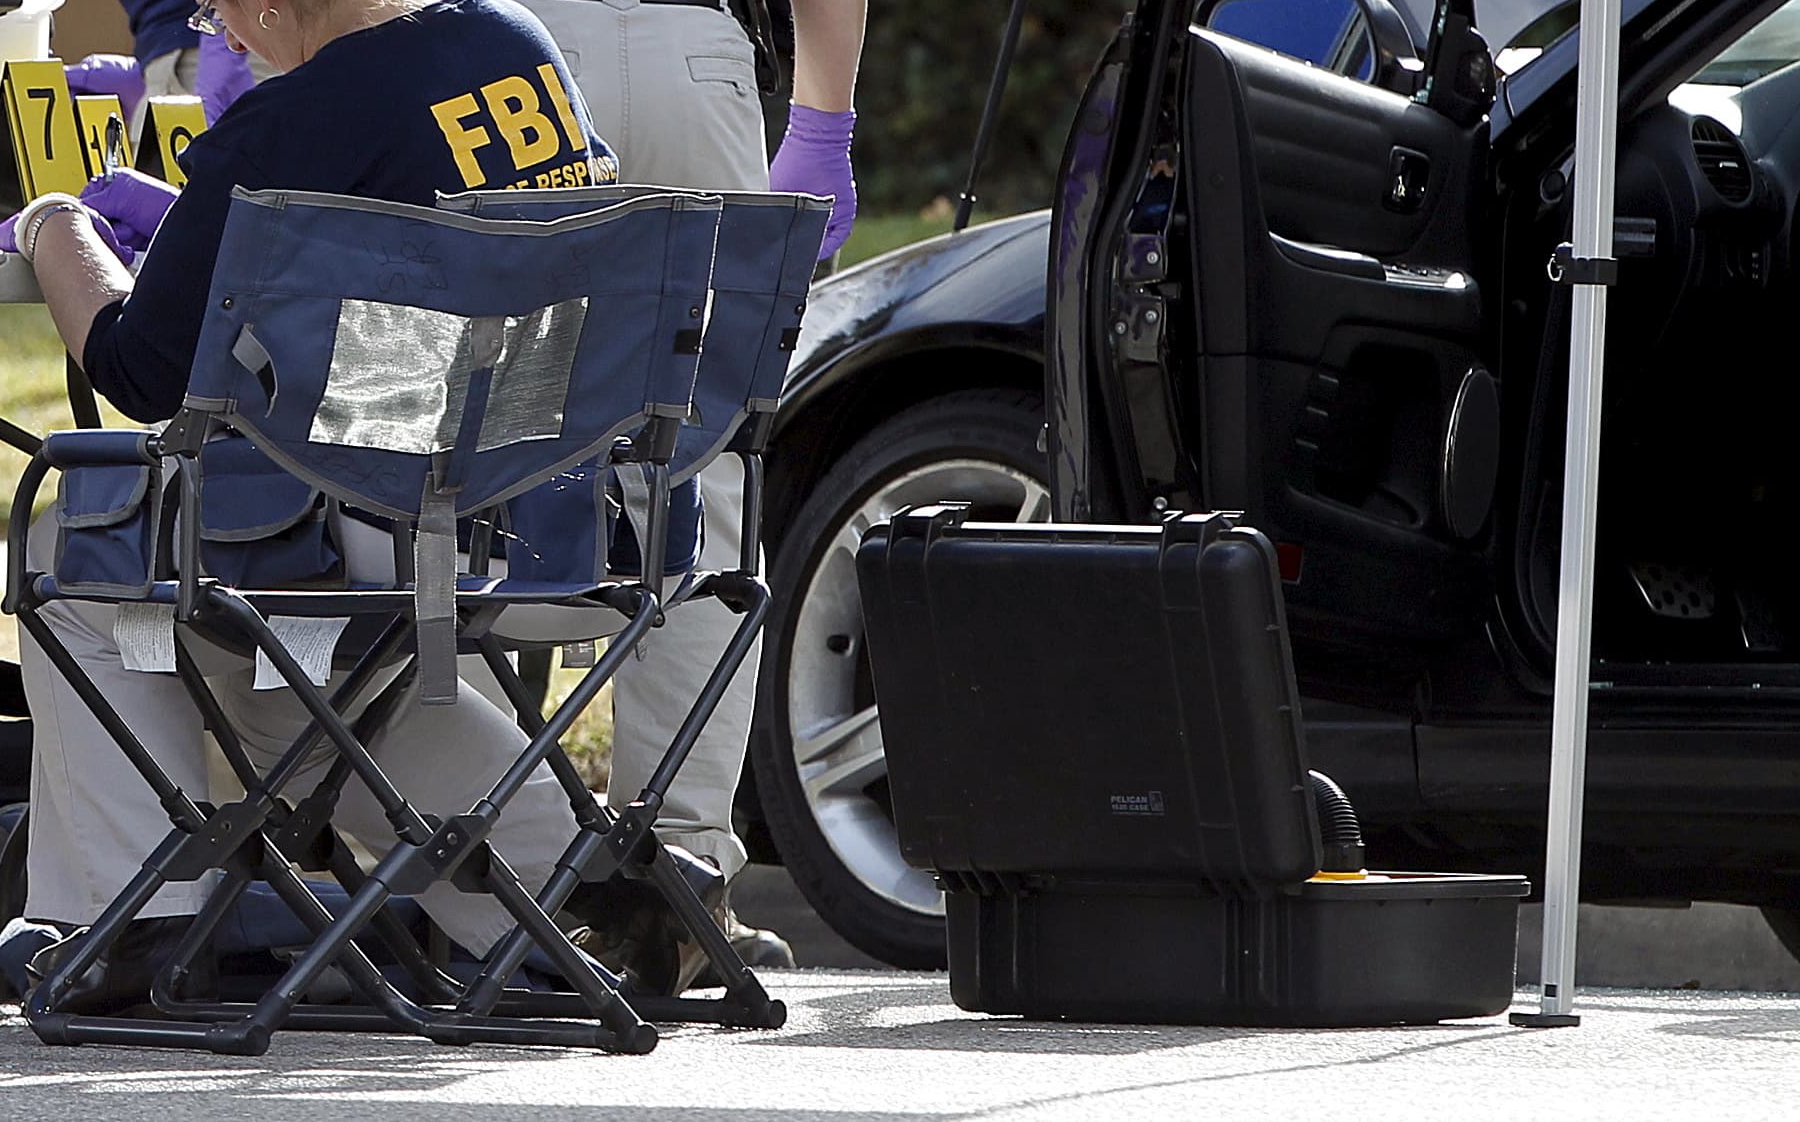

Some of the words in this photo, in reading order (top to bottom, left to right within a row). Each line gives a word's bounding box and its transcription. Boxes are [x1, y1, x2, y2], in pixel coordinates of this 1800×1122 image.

[27, 88, 55, 160] 7
[90, 125, 129, 176] 1
[430, 63, 586, 189] FBI
[1111, 796, 1148, 804] PELICAN
